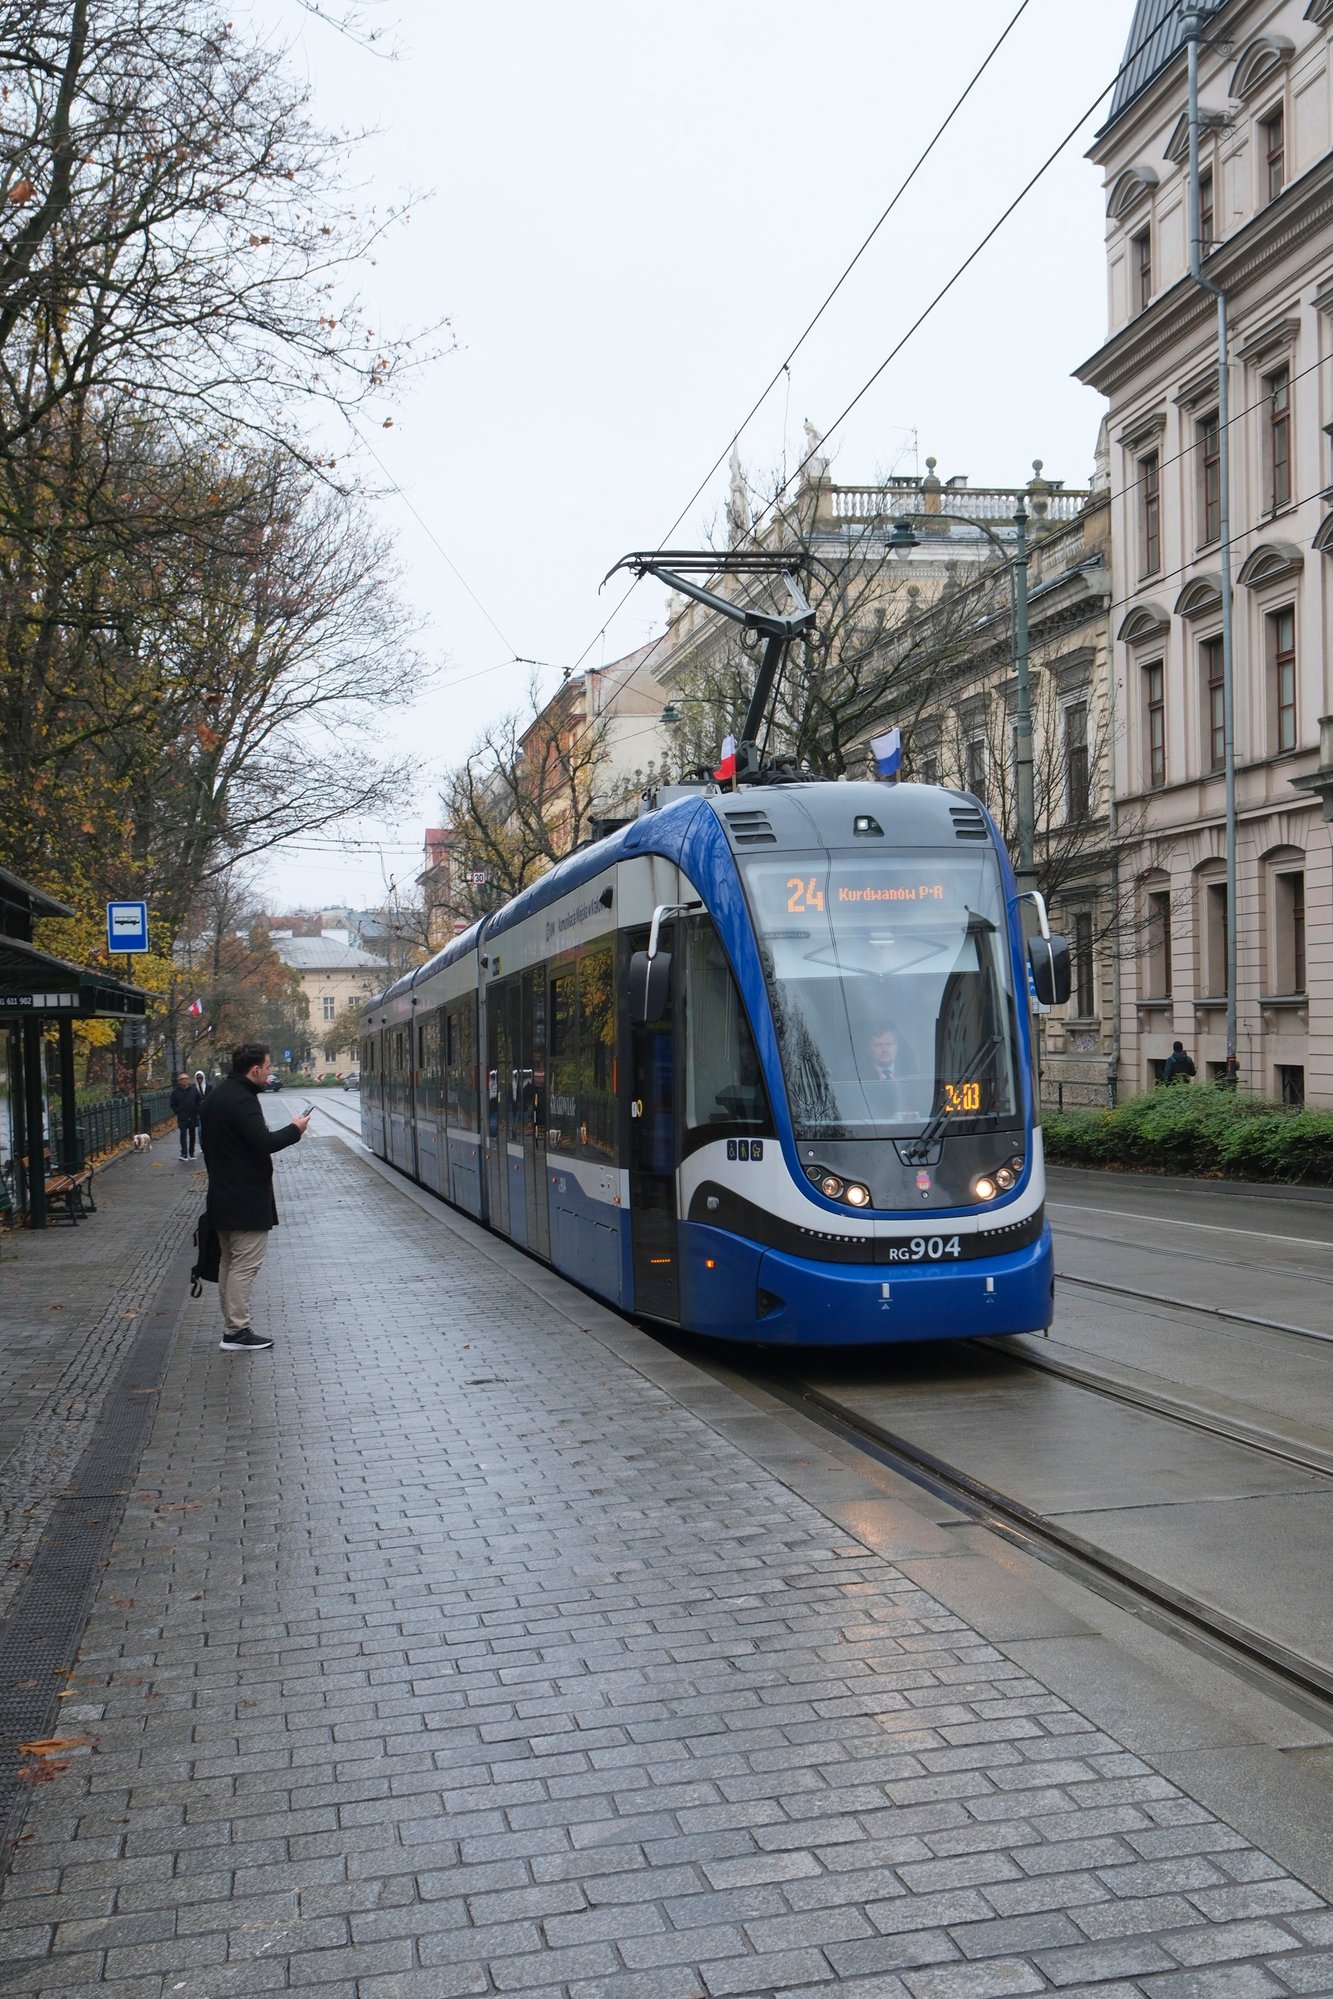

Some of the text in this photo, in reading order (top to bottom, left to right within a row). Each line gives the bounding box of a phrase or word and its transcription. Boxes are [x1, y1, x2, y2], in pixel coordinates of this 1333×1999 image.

[475, 873, 484, 882] 30
[786, 877, 824, 913] 24
[838, 886, 916, 902] Kurdwanów
[6, 997, 18, 1005] 611
